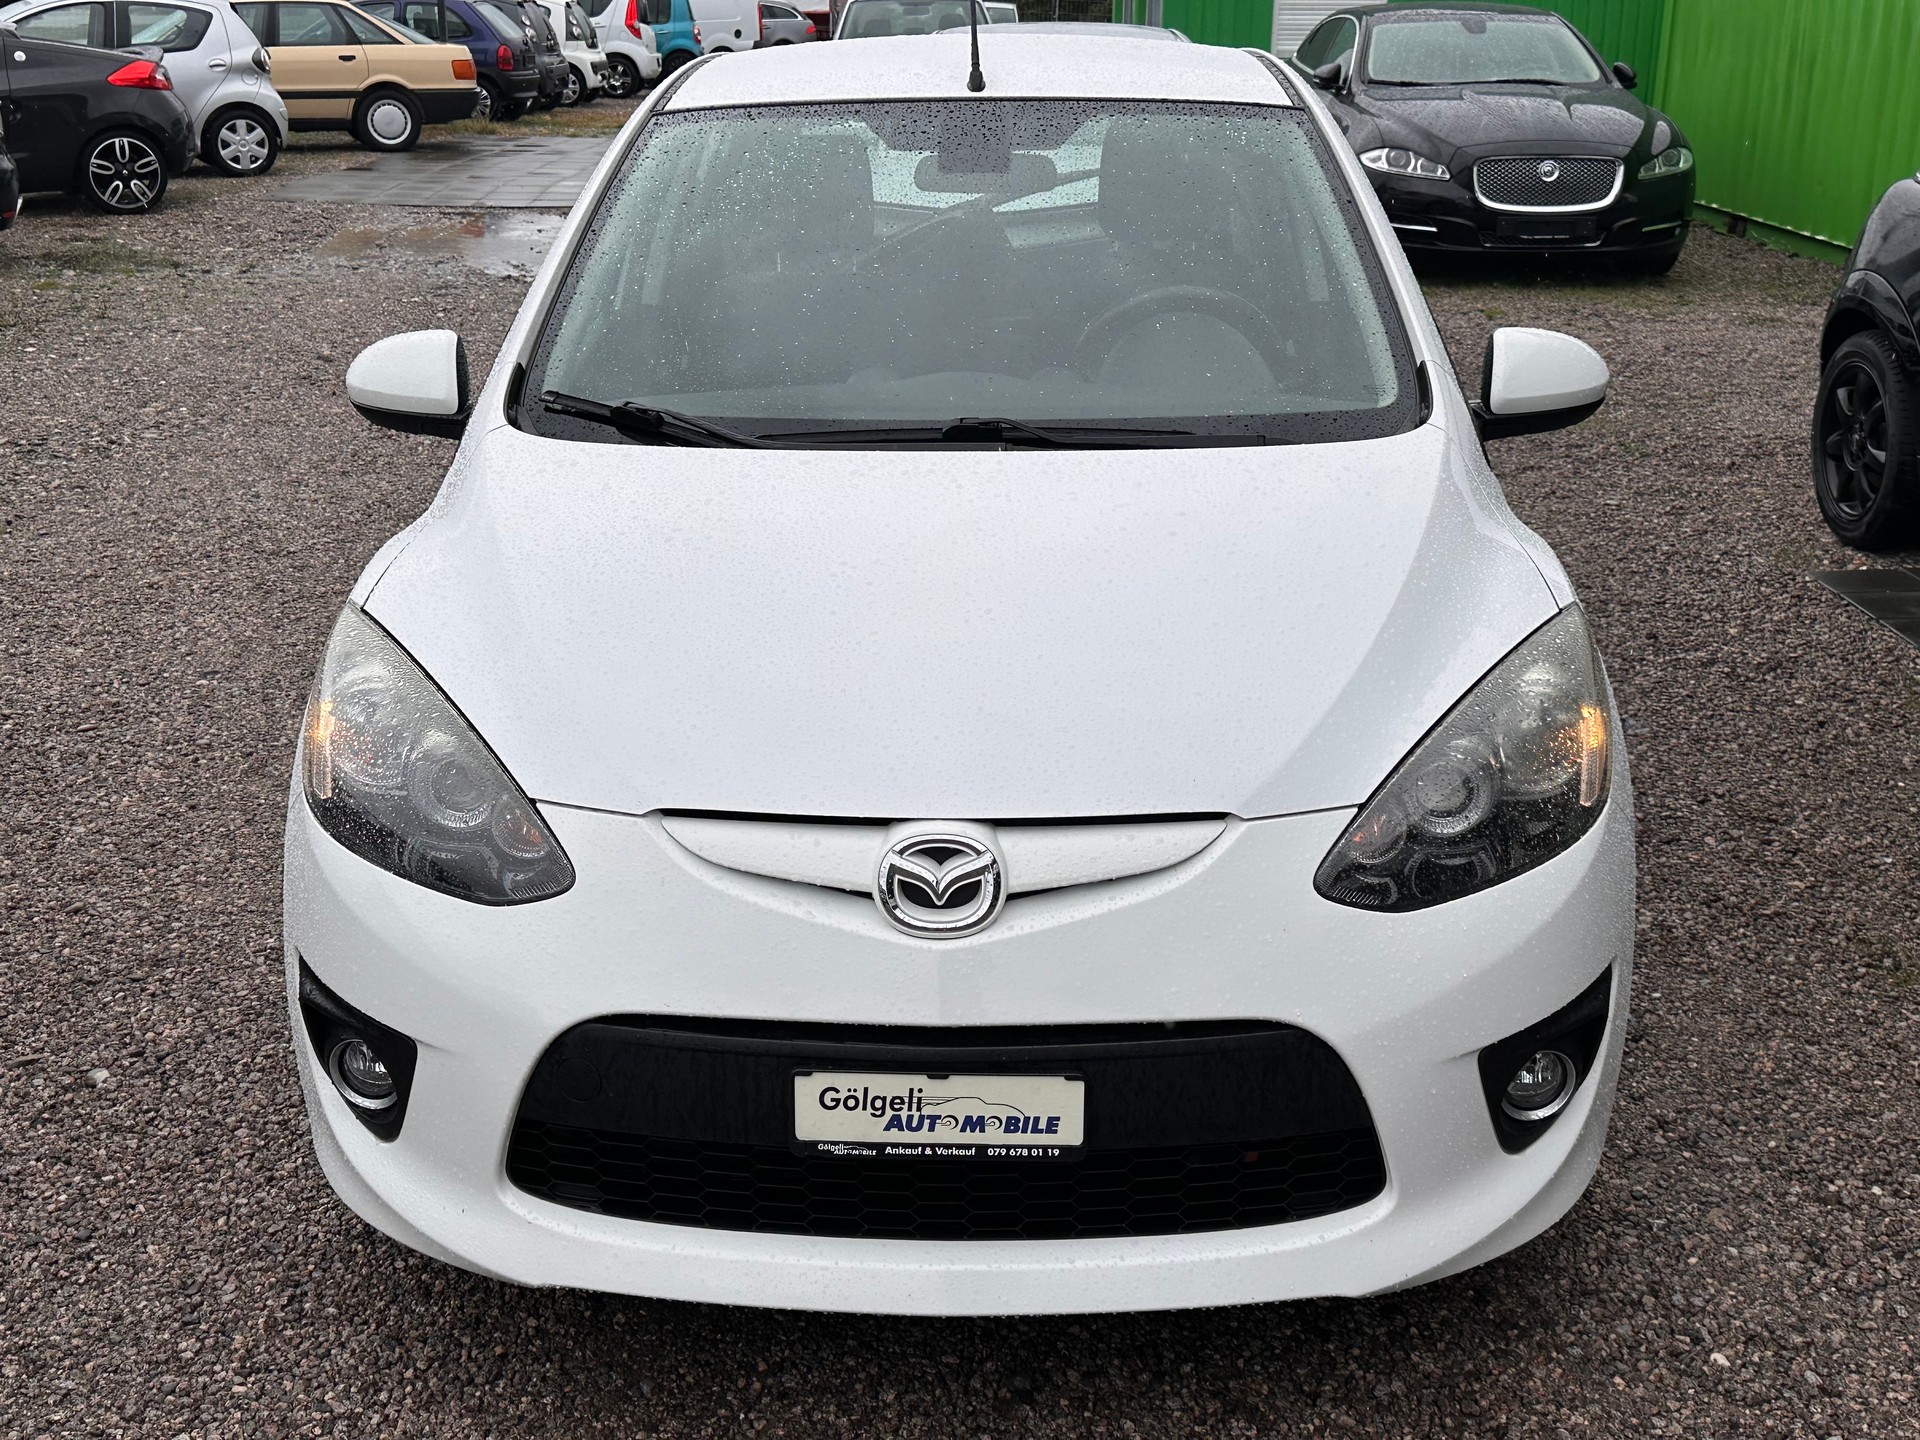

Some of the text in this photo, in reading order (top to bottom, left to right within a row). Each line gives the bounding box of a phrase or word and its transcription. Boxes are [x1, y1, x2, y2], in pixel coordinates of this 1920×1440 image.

[818, 1086, 924, 1118] Gölgeli
[883, 1113, 1061, 1135] AUTOMOBILE
[884, 1146, 1060, 1156] Ankauf & Verkauf 079 678 01 19
